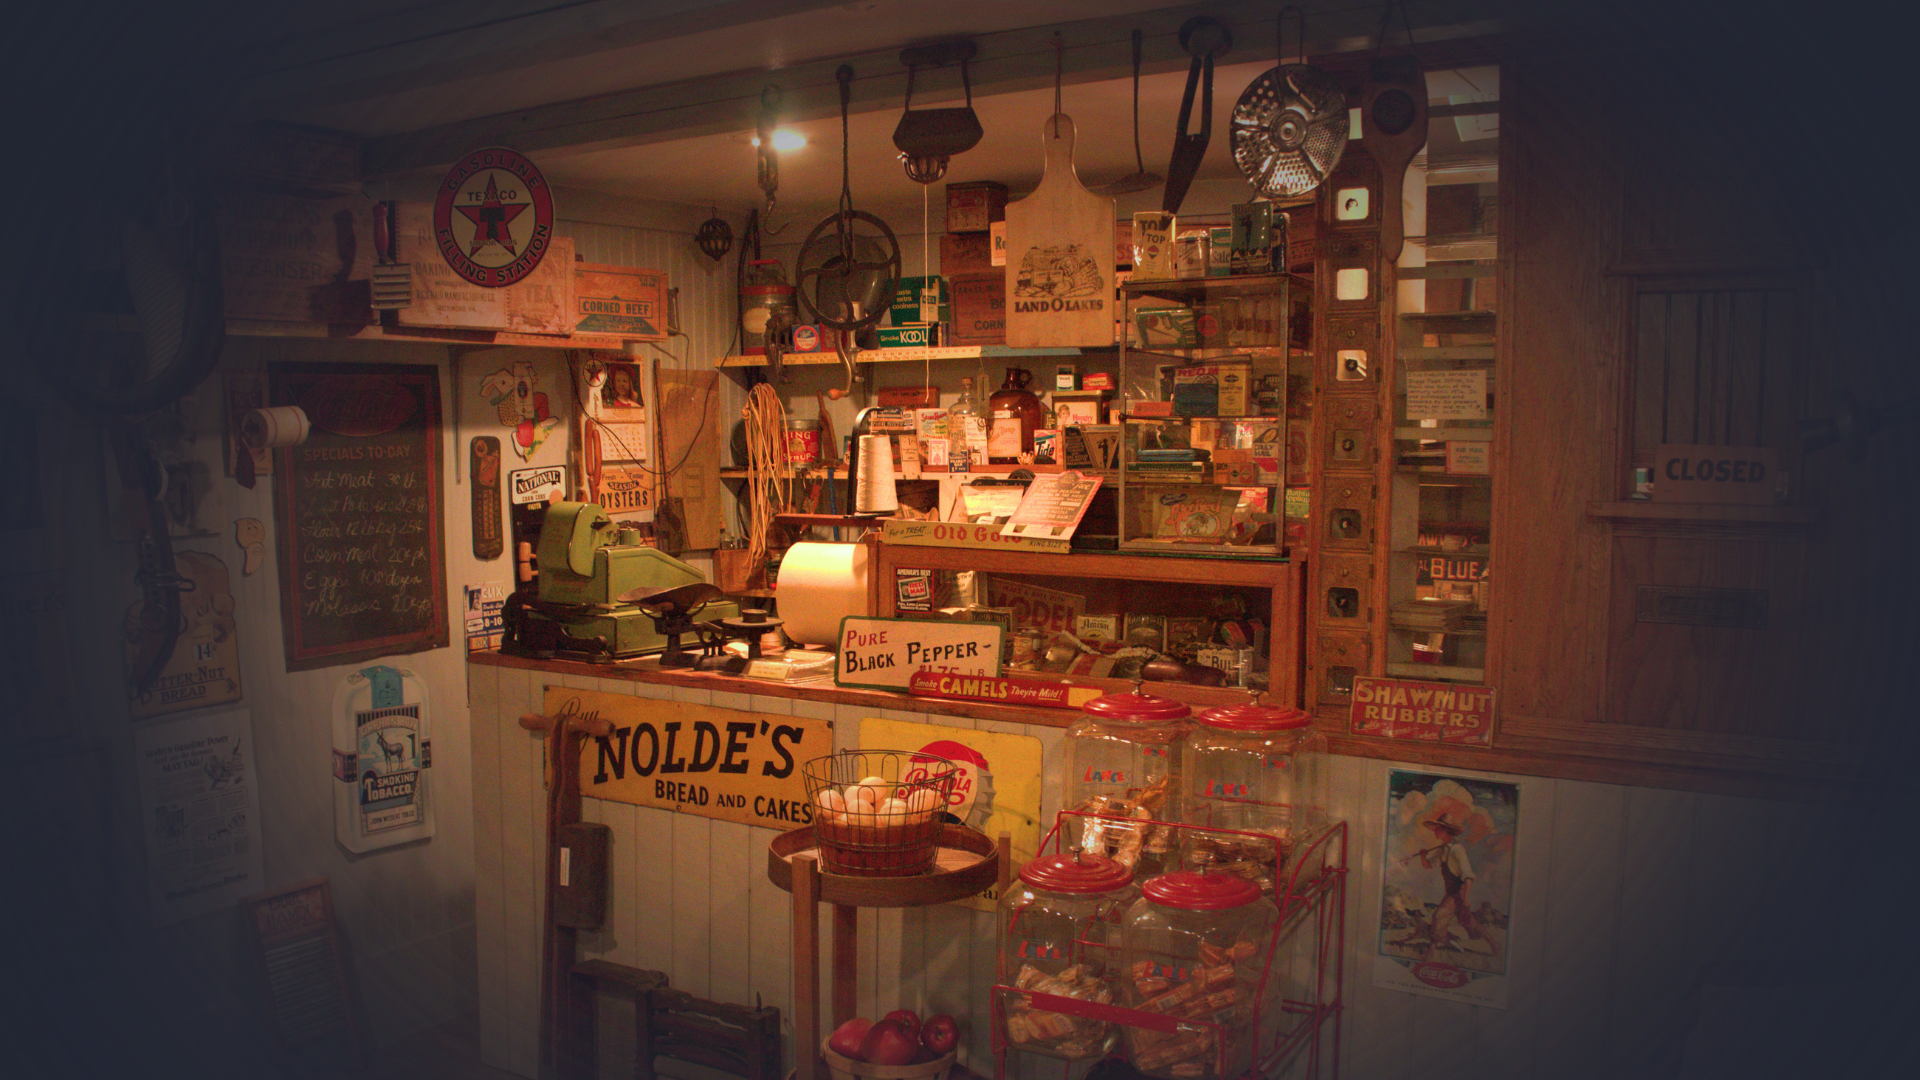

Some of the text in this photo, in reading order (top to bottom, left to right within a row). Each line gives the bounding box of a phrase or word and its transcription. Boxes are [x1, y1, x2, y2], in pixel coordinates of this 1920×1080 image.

[447, 153, 540, 191] GASOLINE
[467, 190, 518, 201] TEXACO
[1147, 233, 1166, 245] TOP
[438, 224, 550, 283] FILLING STATION
[582, 300, 650, 316] CORNED BEEF
[1014, 301, 1050, 313] LAND
[1064, 300, 1104, 312] LAKES
[304, 447, 364, 461] SPECIALS
[1036, 440, 1055, 456] Tide
[1253, 443, 1274, 451] DAILY
[1253, 450, 1272, 458] MAIL
[338, 469, 376, 490] Meat
[628, 472, 645, 482] Today
[1664, 457, 1766, 484] CLOSED
[516, 470, 561, 494] NATIONAL
[600, 490, 649, 510] OYSTERS
[301, 519, 342, 539] Flour
[933, 524, 968, 542] Old
[303, 542, 342, 563] Corn
[1430, 557, 1479, 581] BLUE
[303, 569, 349, 601] Eggs
[481, 586, 505, 599] CLIX
[484, 616, 503, 628] 8-10
[845, 629, 889, 649] PURE
[845, 649, 895, 673] BLACK
[160, 684, 207, 704] BREAD
[913, 676, 1063, 699] Smoke CAMELS They're Mild!
[1356, 680, 1491, 713] SHAWMUT
[1364, 705, 1480, 729] RUBBERS
[174, 739, 205, 752] Gasoline
[207, 735, 229, 747] Power
[593, 719, 805, 785] NOLDE'S
[162, 756, 205, 774] MAYTAG!
[377, 772, 415, 789] SMOKING
[655, 779, 815, 825] BREAD AND CAKES
[1419, 965, 1461, 985] Coca-Cola
